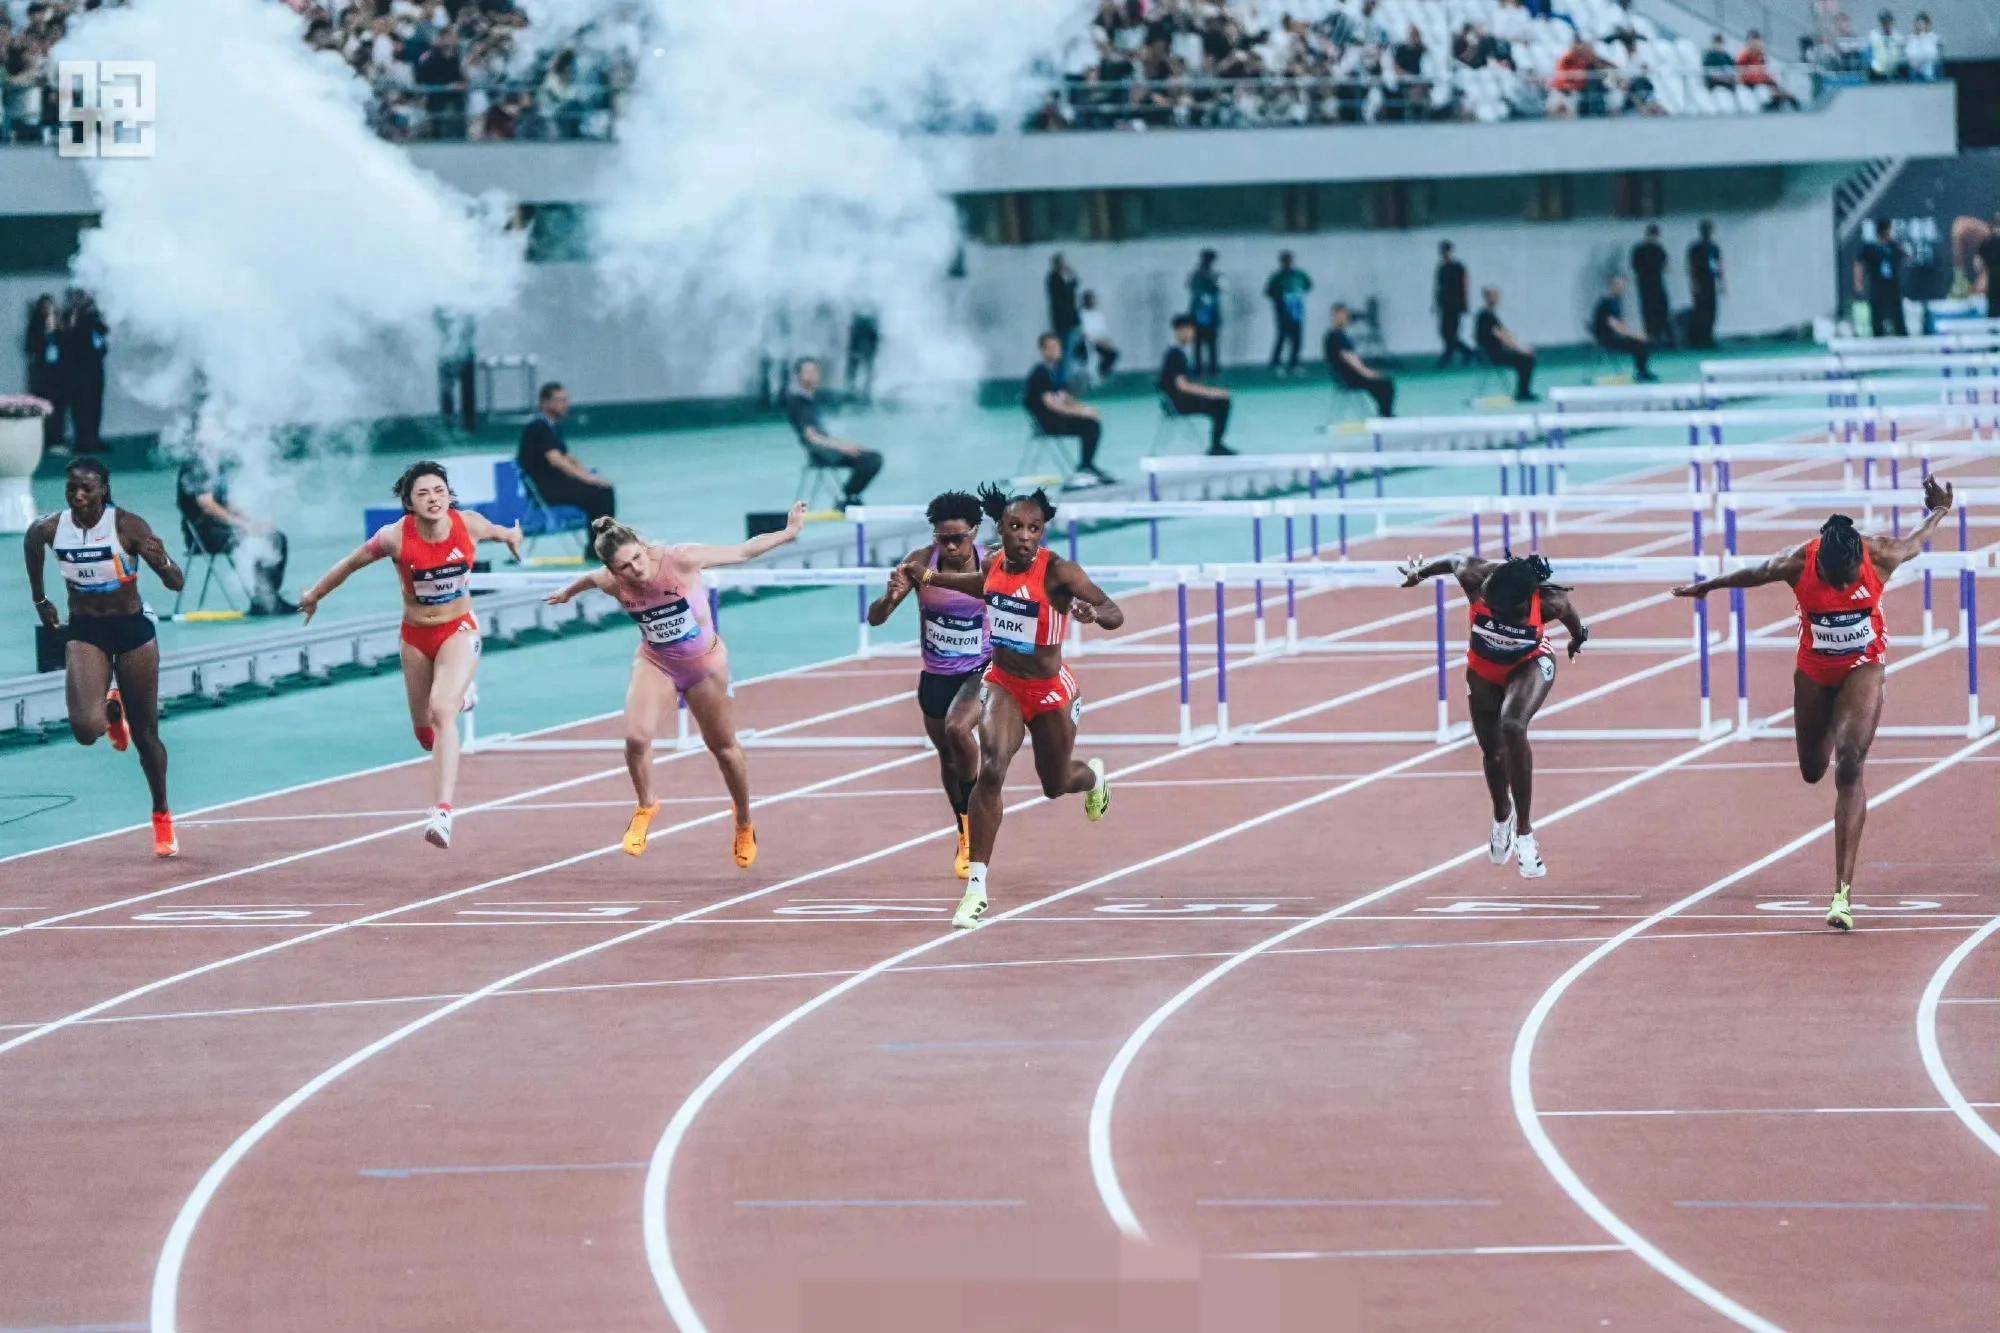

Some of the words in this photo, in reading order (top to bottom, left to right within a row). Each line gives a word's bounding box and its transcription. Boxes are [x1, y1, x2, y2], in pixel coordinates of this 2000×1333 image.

[78, 569, 96, 578] ALI
[435, 582, 453, 591] WU
[656, 628, 681, 639] WSKA
[1815, 625, 1869, 642] WILLIAMS
